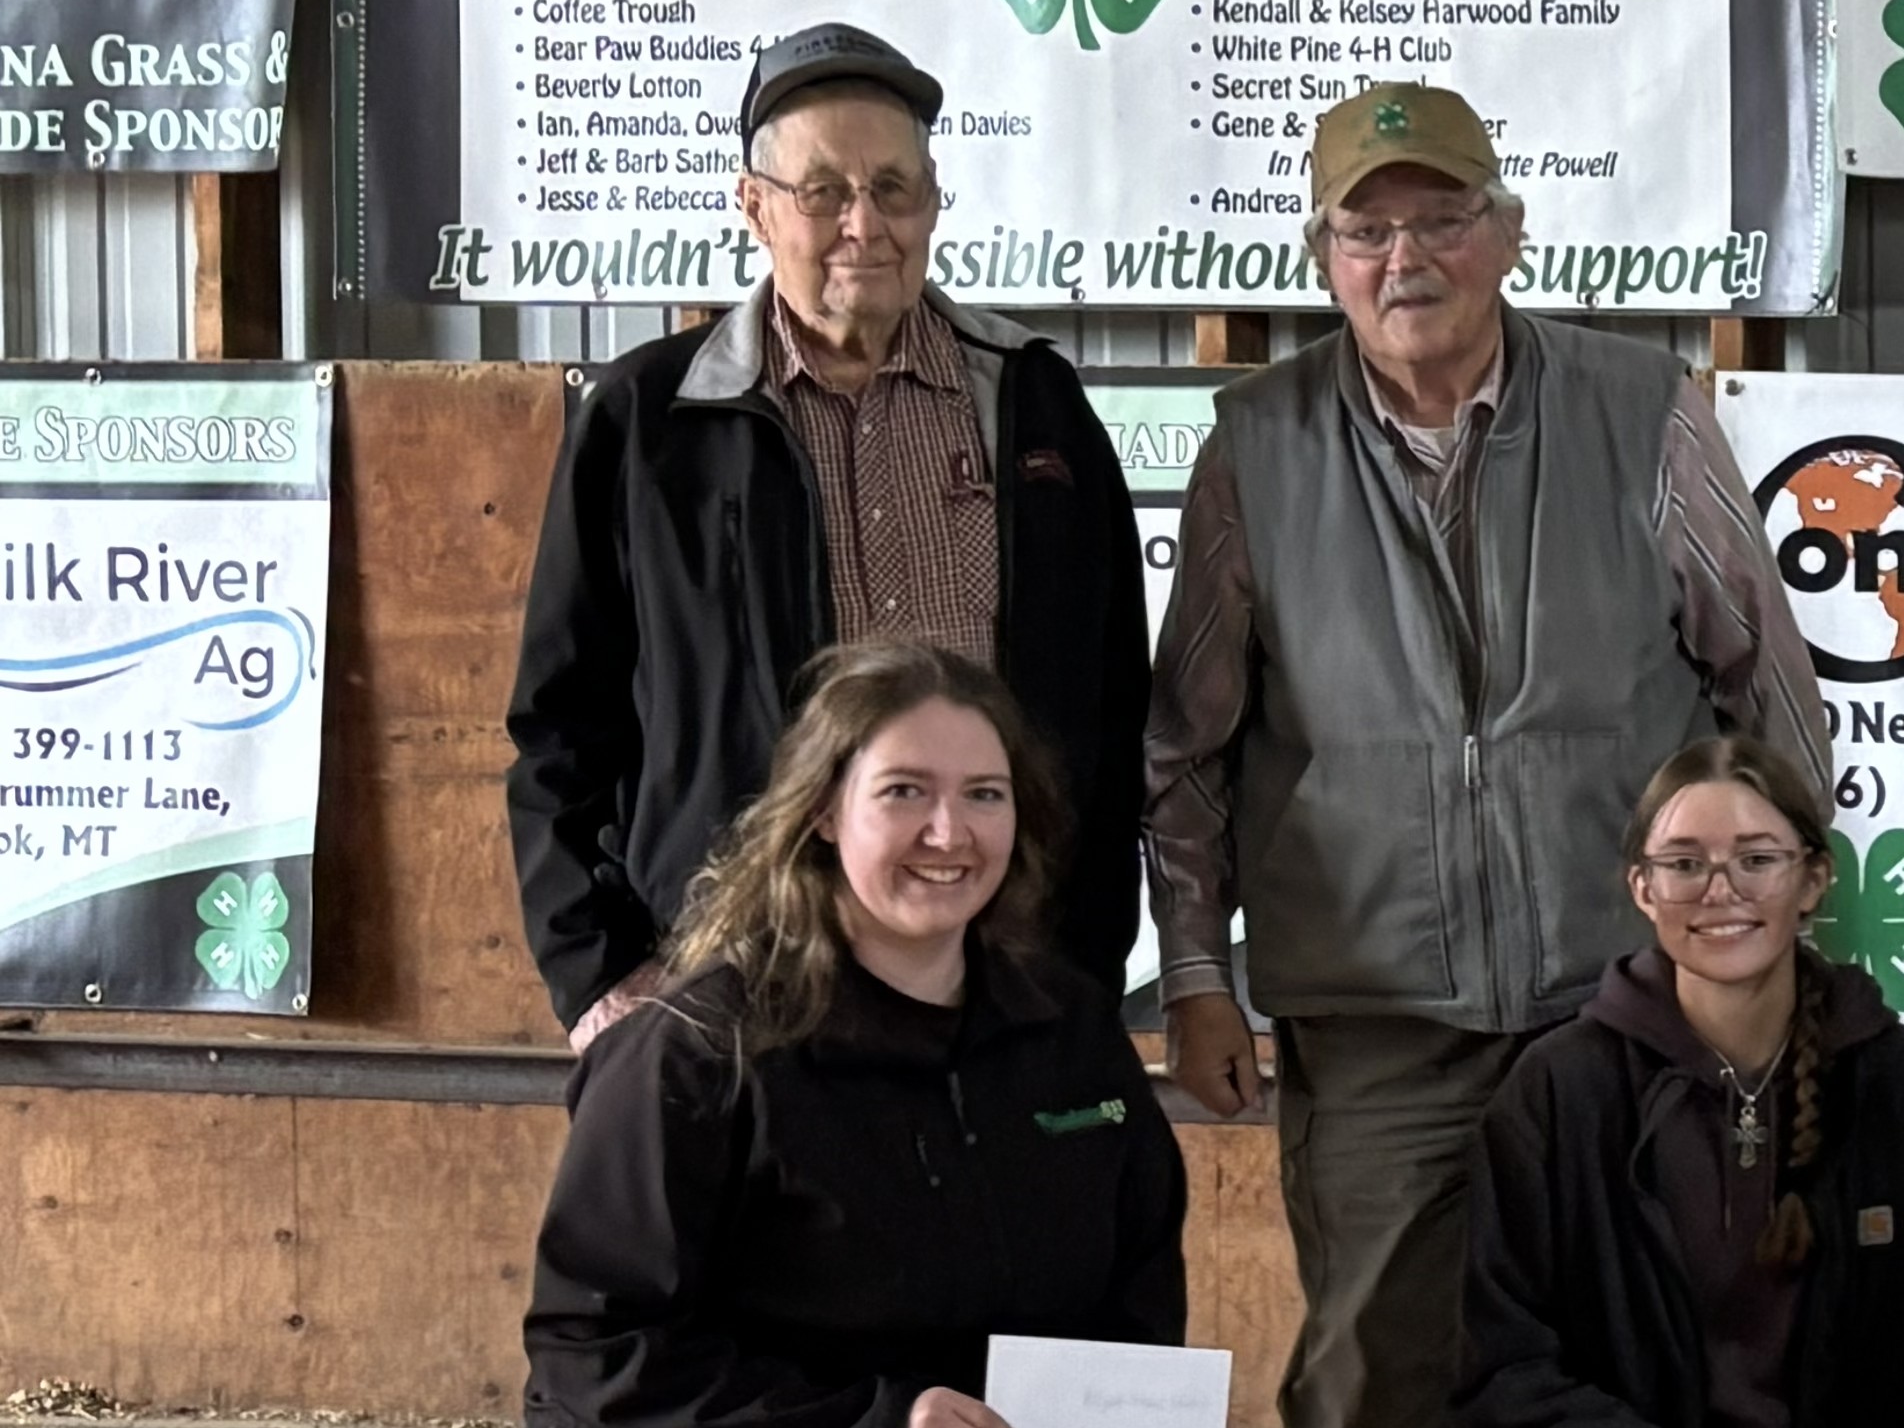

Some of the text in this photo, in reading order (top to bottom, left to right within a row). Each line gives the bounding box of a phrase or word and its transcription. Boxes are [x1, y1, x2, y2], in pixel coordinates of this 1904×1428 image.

[92, 28, 256, 92] GRASS
[535, 35, 742, 61] Bear Paw Buddies
[1212, 35, 1451, 62] White Pine 4-H Club
[536, 72, 701, 99] Beverly Lotton
[1212, 73, 1346, 101] Secret Sun
[538, 111, 1031, 138] Ian, Amanda, Davies
[1212, 111, 1307, 138] Gene &
[537, 148, 668, 174] Jeff & Barb
[1540, 151, 1618, 178] Powell
[536, 186, 727, 211] Jesse & Rebecca
[1212, 187, 1301, 214] Andrea
[431, 224, 1768, 304] It wouldn't ssible withou support!
[34, 406, 297, 463] SPONSORS
[107, 543, 277, 603] River
[194, 635, 273, 699] Ag
[14, 728, 181, 761] 399-1113
[144, 777, 230, 816] Lane,
[62, 825, 117, 856] MT
